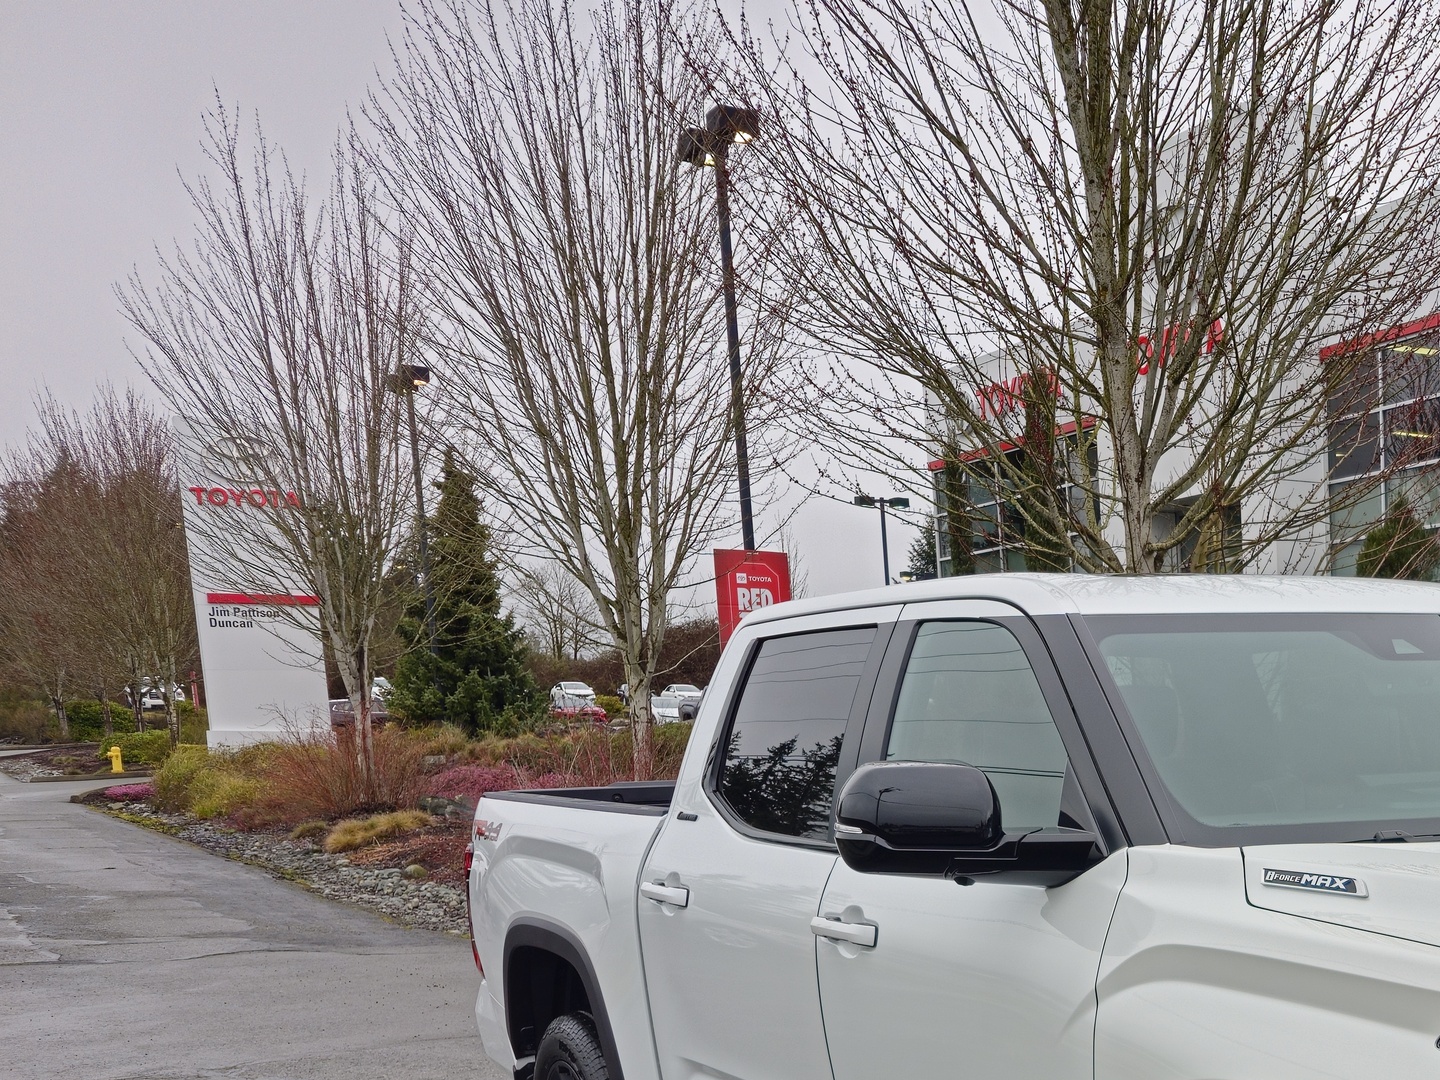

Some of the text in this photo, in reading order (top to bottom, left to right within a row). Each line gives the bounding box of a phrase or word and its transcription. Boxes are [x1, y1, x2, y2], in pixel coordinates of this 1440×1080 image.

[189, 487, 302, 509] TOYOTA
[748, 575, 772, 583] TOYOTA
[737, 587, 774, 611] RED
[208, 606, 280, 618] Jim Pattison
[209, 617, 253, 628] Duncan
[1300, 873, 1348, 890] MAX
